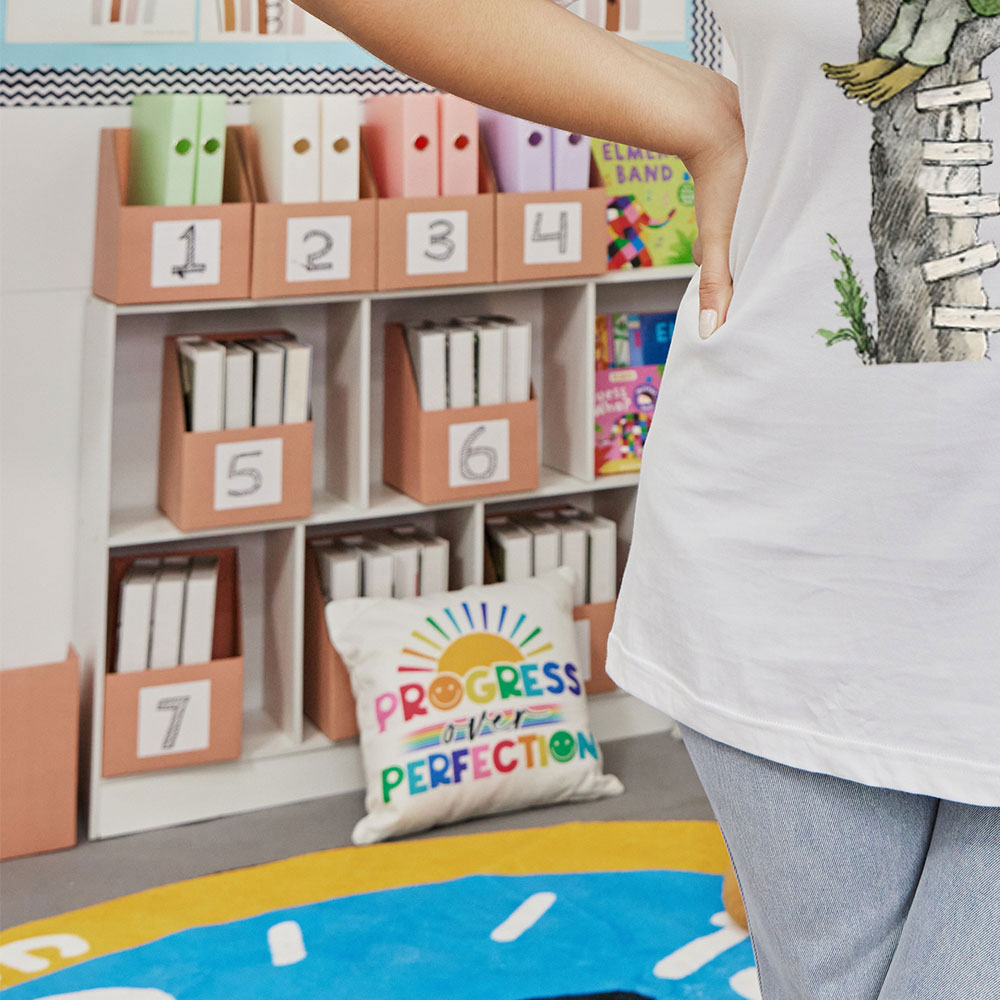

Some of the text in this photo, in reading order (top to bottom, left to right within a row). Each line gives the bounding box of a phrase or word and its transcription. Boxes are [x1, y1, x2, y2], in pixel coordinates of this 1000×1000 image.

[616, 164, 673, 184] BAND
[172, 223, 207, 279] 1
[302, 229, 334, 271] 2
[424, 218, 456, 262] 3
[531, 210, 568, 254] 4
[227, 449, 264, 497] 5
[459, 425, 498, 481] 6
[374, 661, 583, 734] PROGRESS
[155, 695, 191, 750] 7
[443, 708, 535, 744] over
[380, 728, 599, 804] PERFECTION
